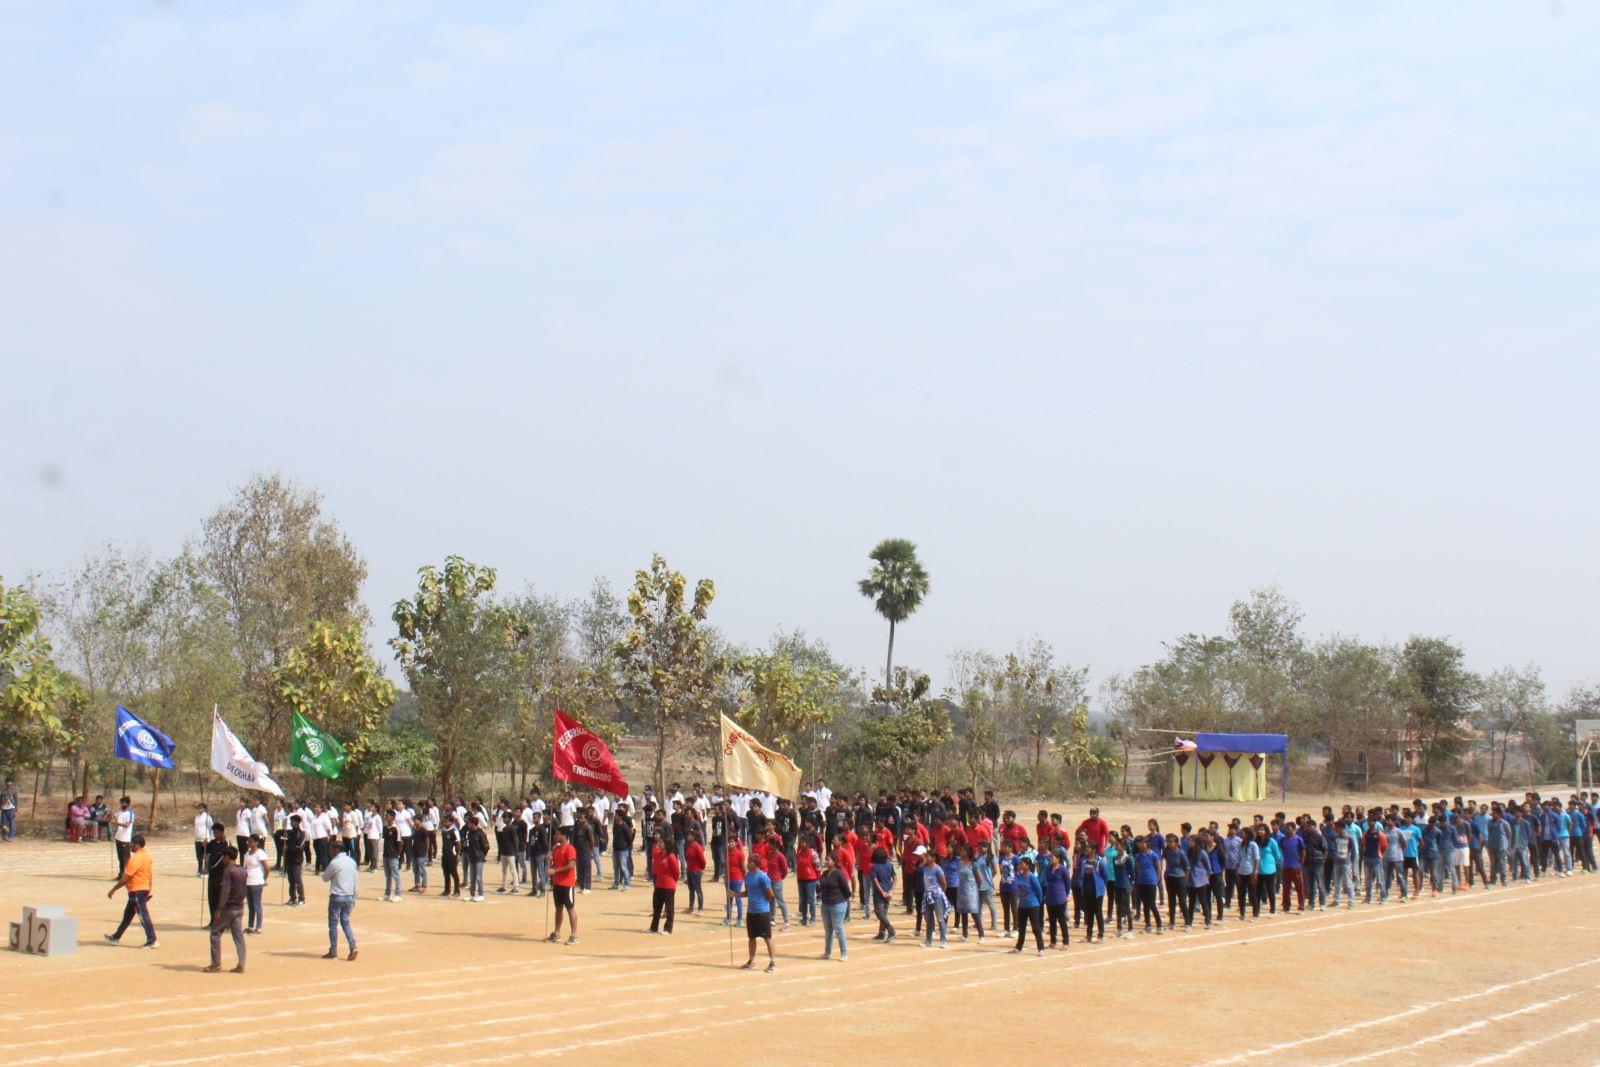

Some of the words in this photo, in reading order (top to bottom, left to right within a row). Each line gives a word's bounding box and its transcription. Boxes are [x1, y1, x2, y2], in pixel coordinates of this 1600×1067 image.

[10, 922, 20, 950] 3
[26, 912, 33, 953] 1
[37, 923, 47, 954] 2
